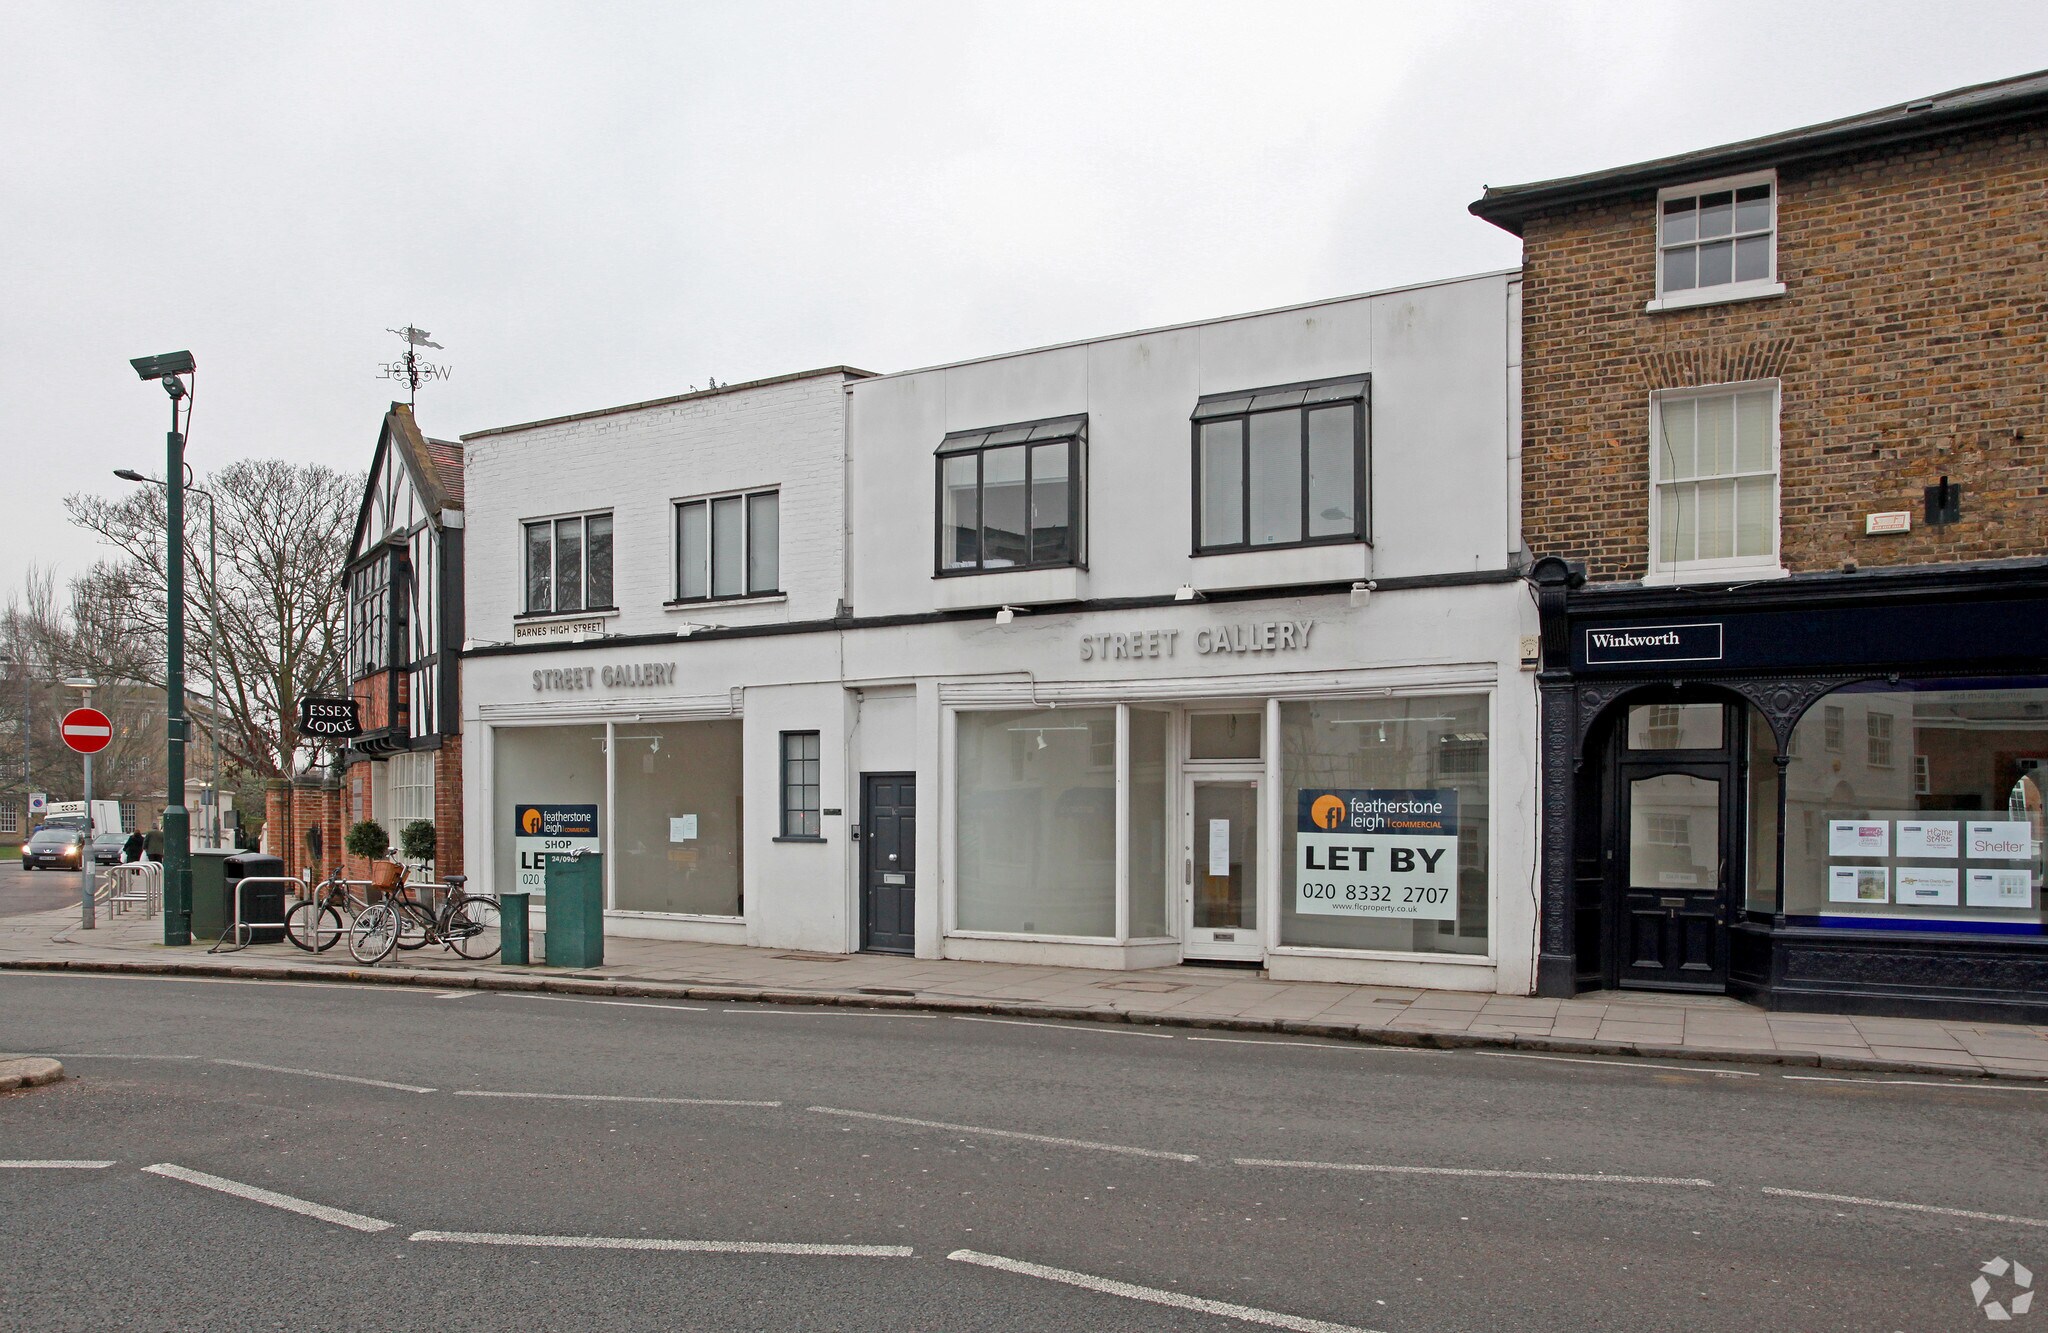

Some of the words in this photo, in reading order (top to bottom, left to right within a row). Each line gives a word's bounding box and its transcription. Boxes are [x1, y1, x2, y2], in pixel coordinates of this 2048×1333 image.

[517, 626, 547, 638] BARNES
[550, 625, 570, 635] HIGH
[573, 622, 601, 633] STREET
[1079, 628, 1178, 661] STREET
[1197, 619, 1314, 655] GALLERY
[1592, 631, 1680, 648] Winkworth
[532, 666, 594, 691] STREET
[601, 662, 676, 688] GALLERY
[310, 704, 352, 717] ESSEX
[307, 717, 355, 734] LODGE
[1350, 797, 1443, 814] featherstone
[543, 810, 592, 822] featherstone
[1350, 813, 1385, 831] leigh
[1391, 820, 1442, 829] COMMERCIAL
[543, 821, 562, 836] leigh
[544, 840, 572, 849] SHOP
[1974, 840, 2025, 853] Shelter
[521, 851, 545, 870] LE
[1305, 845, 1375, 872] LET
[1390, 847, 1446, 874] BY
[522, 873, 540, 885] 020
[1303, 883, 1336, 899] 020
[1345, 884, 1391, 902] 8332
[1403, 886, 1449, 904] 2707
[1332, 902, 1418, 914] www.flcproperty.co.uk
